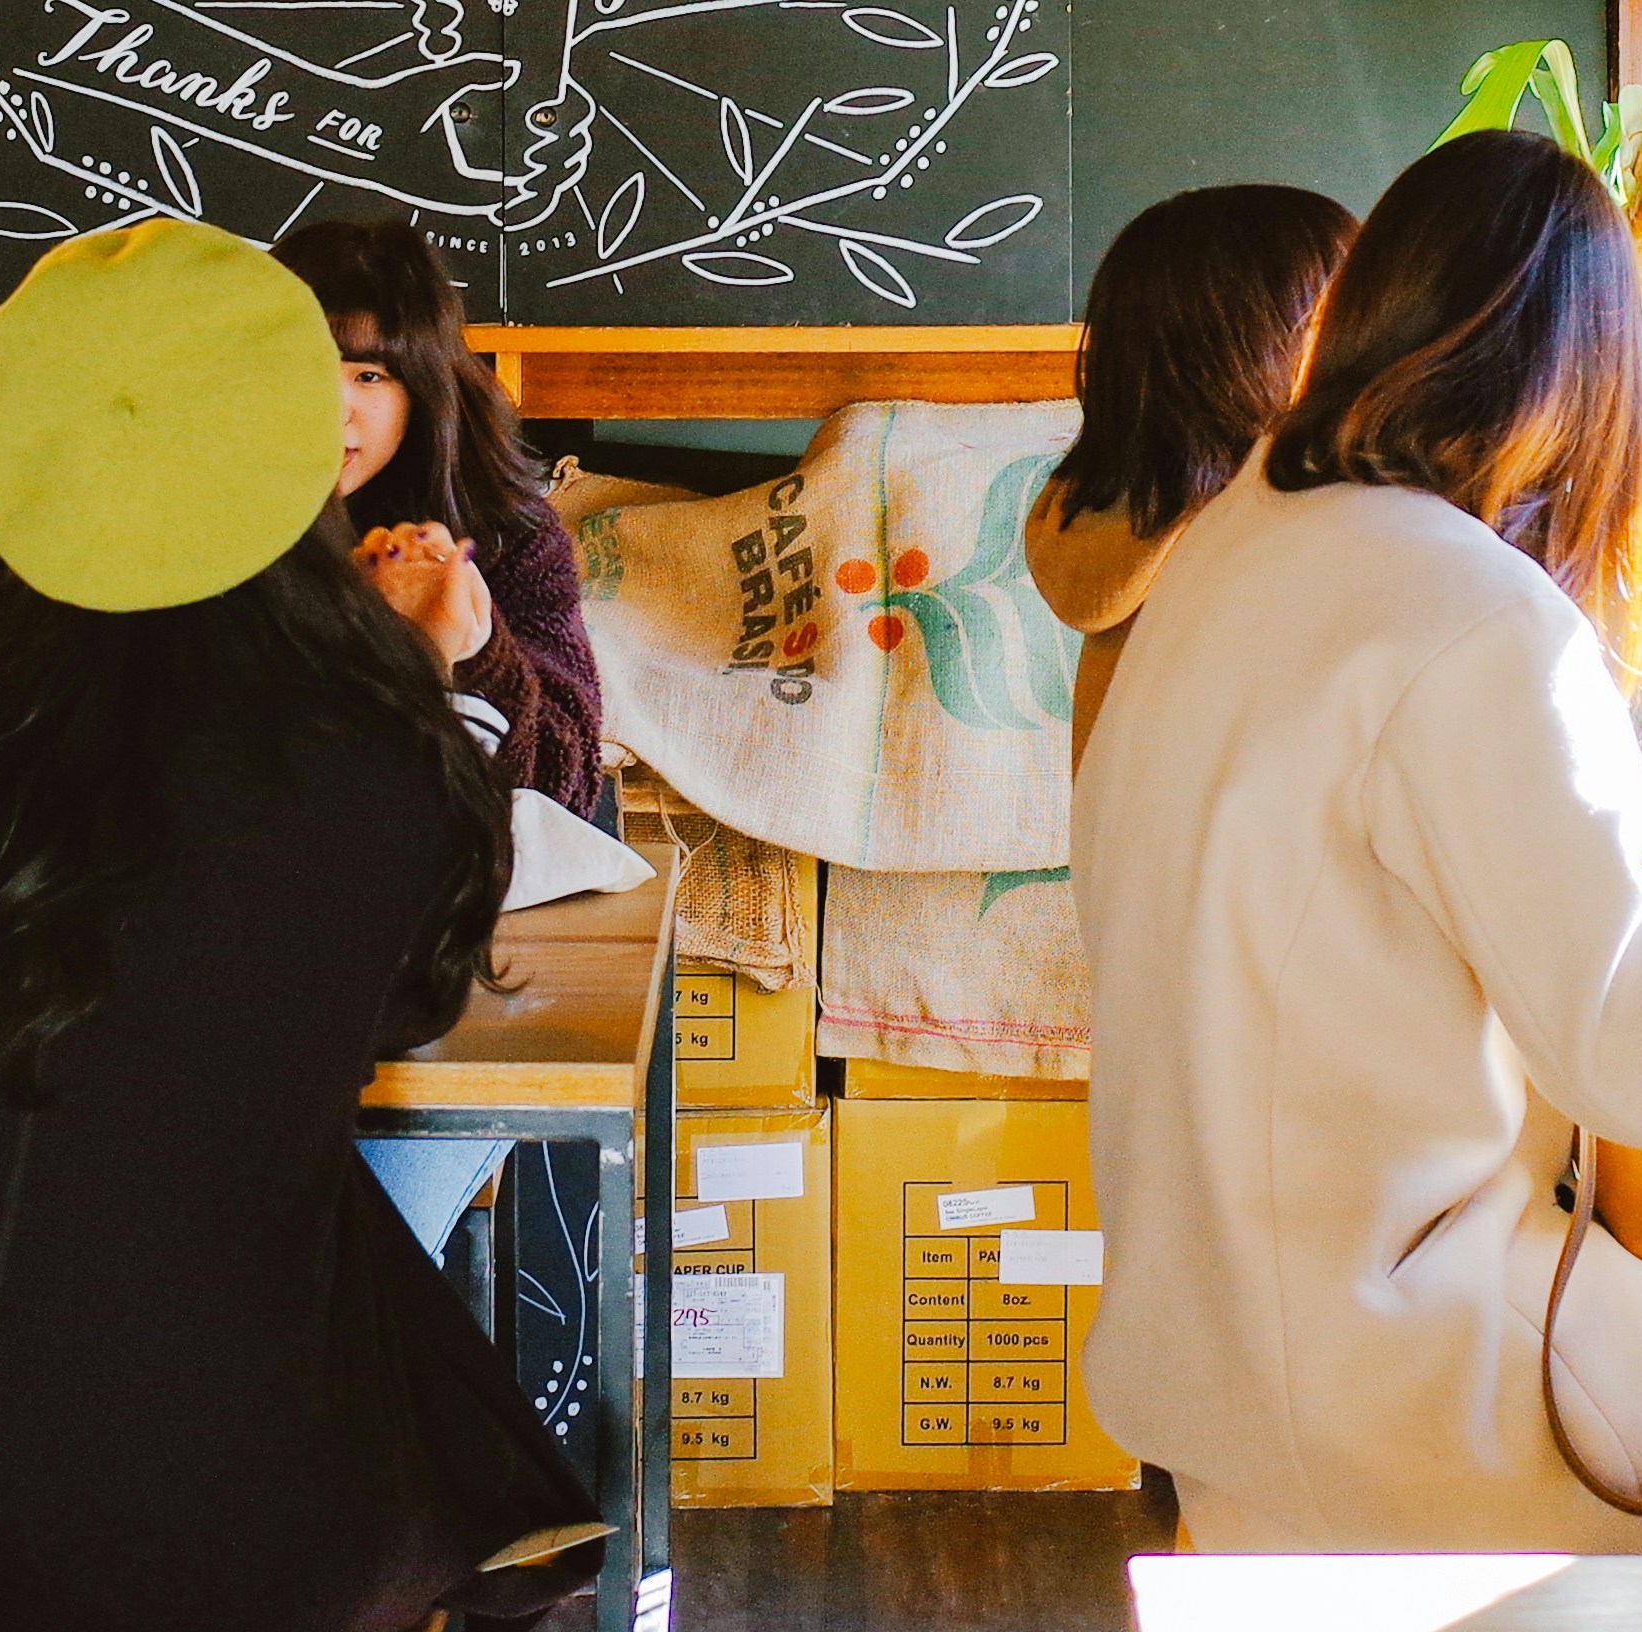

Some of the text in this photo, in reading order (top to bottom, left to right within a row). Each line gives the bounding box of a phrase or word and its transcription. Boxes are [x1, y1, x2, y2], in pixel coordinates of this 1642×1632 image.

[316, 109, 383, 150] FOR
[519, 231, 576, 256] 2013
[691, 990, 709, 1006] kg
[691, 1032, 709, 1048] kg
[922, 1250, 953, 1263] Item
[908, 1293, 1032, 1306] Content 8oz.
[907, 1333, 1049, 1349] Quantity 1000 pcs
[920, 1376, 1040, 1391] N.W. 8.7 kg
[681, 1391, 729, 1406] 8.7 kg
[919, 1417, 1040, 1433] G.W. 9.5 kg
[681, 1432, 729, 1448] 9.5 kg
